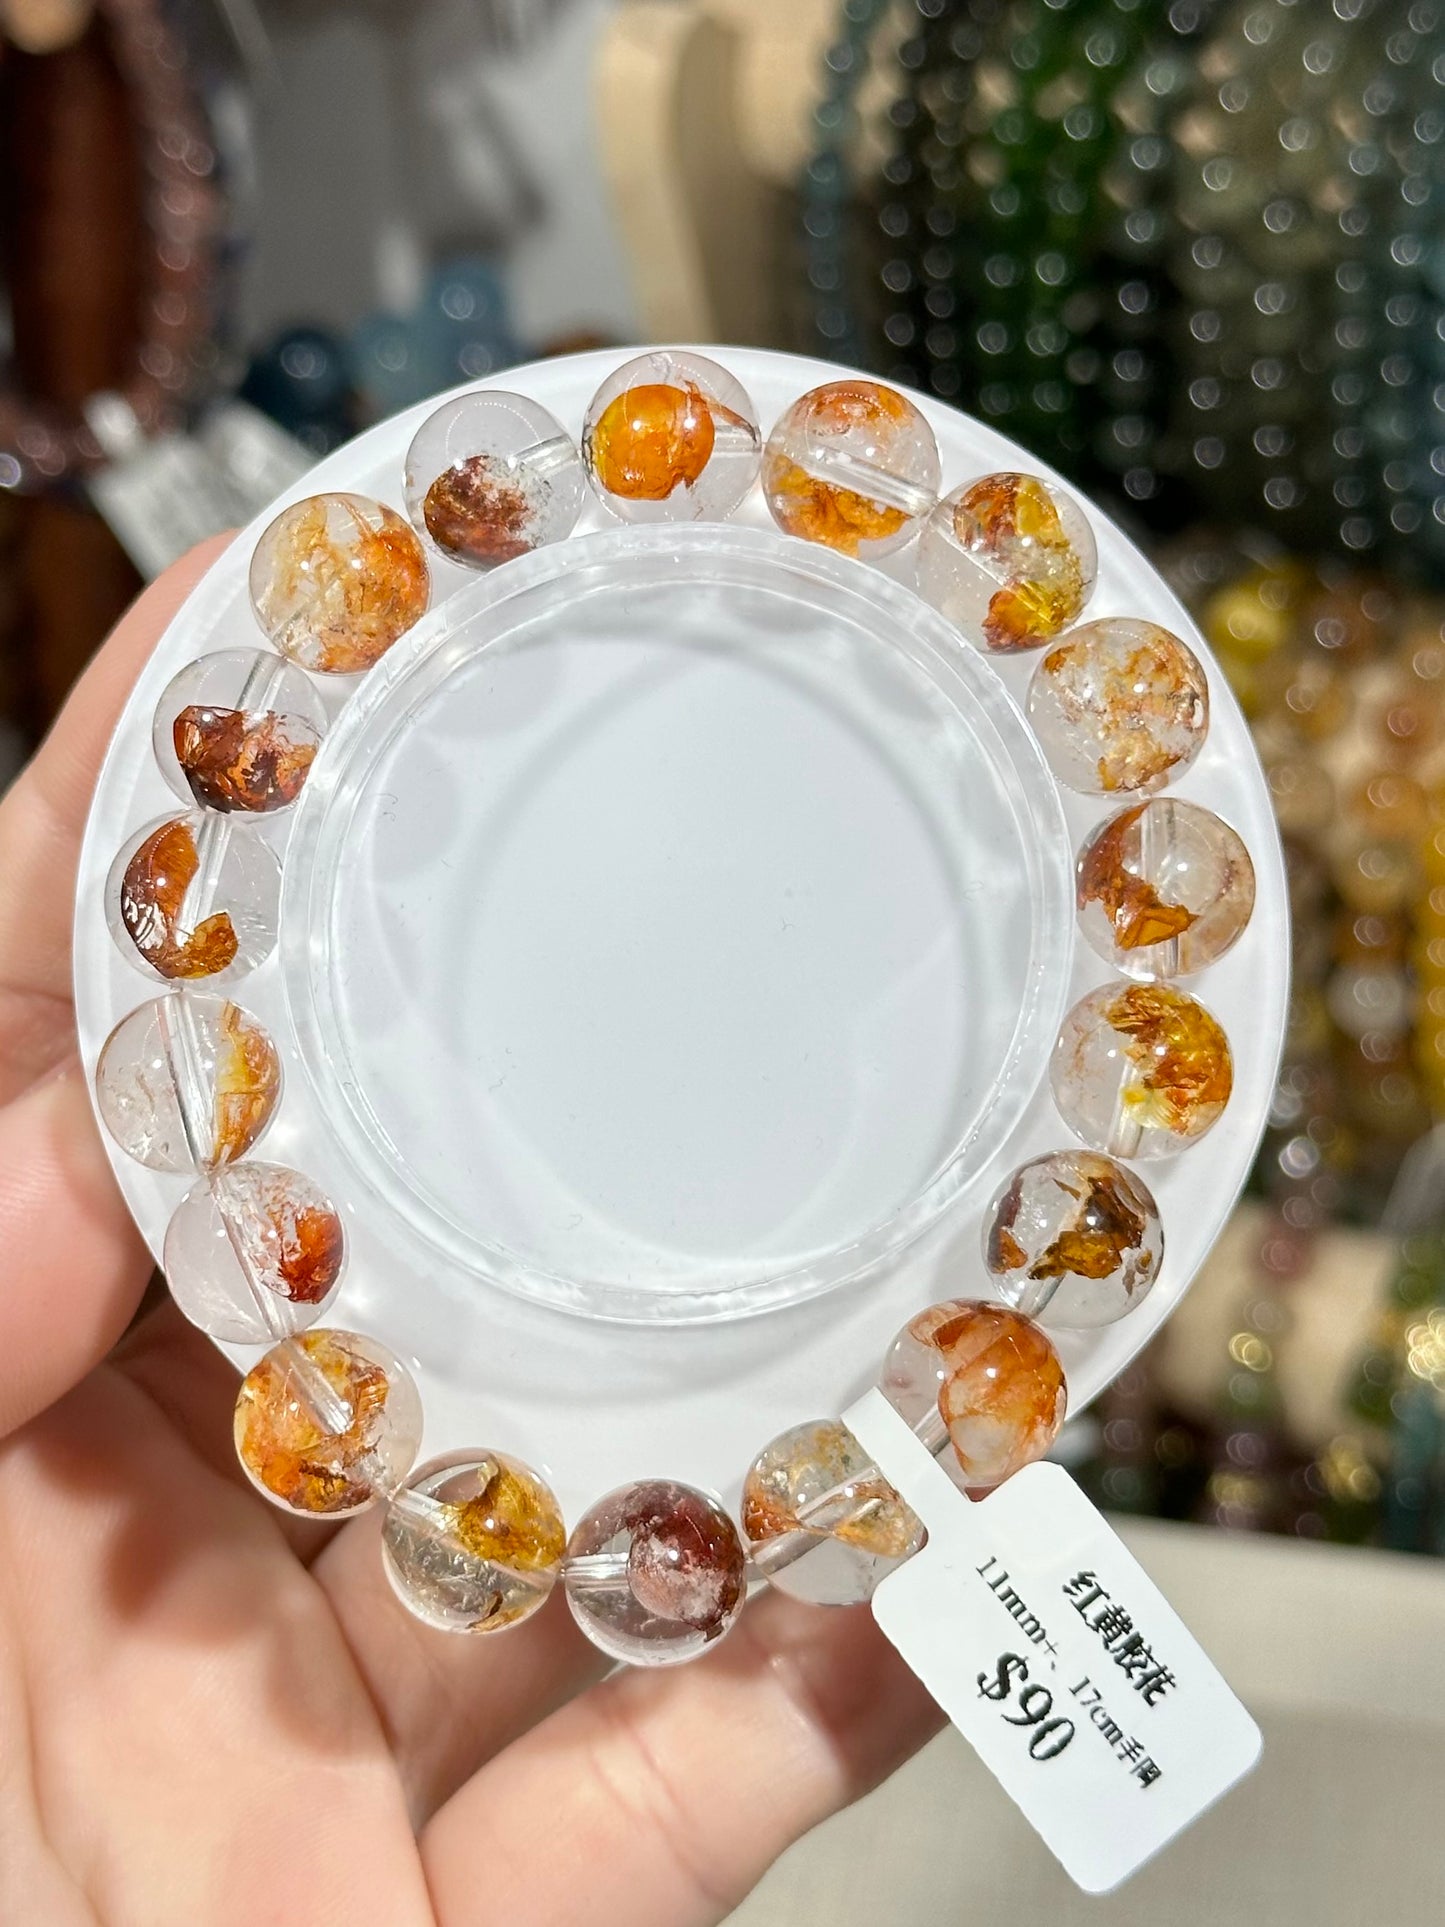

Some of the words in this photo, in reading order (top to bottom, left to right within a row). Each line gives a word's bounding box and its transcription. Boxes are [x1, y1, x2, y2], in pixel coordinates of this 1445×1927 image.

[1062, 1570, 1177, 1708] 红黄胶花
[976, 1651, 1075, 1761] $90
